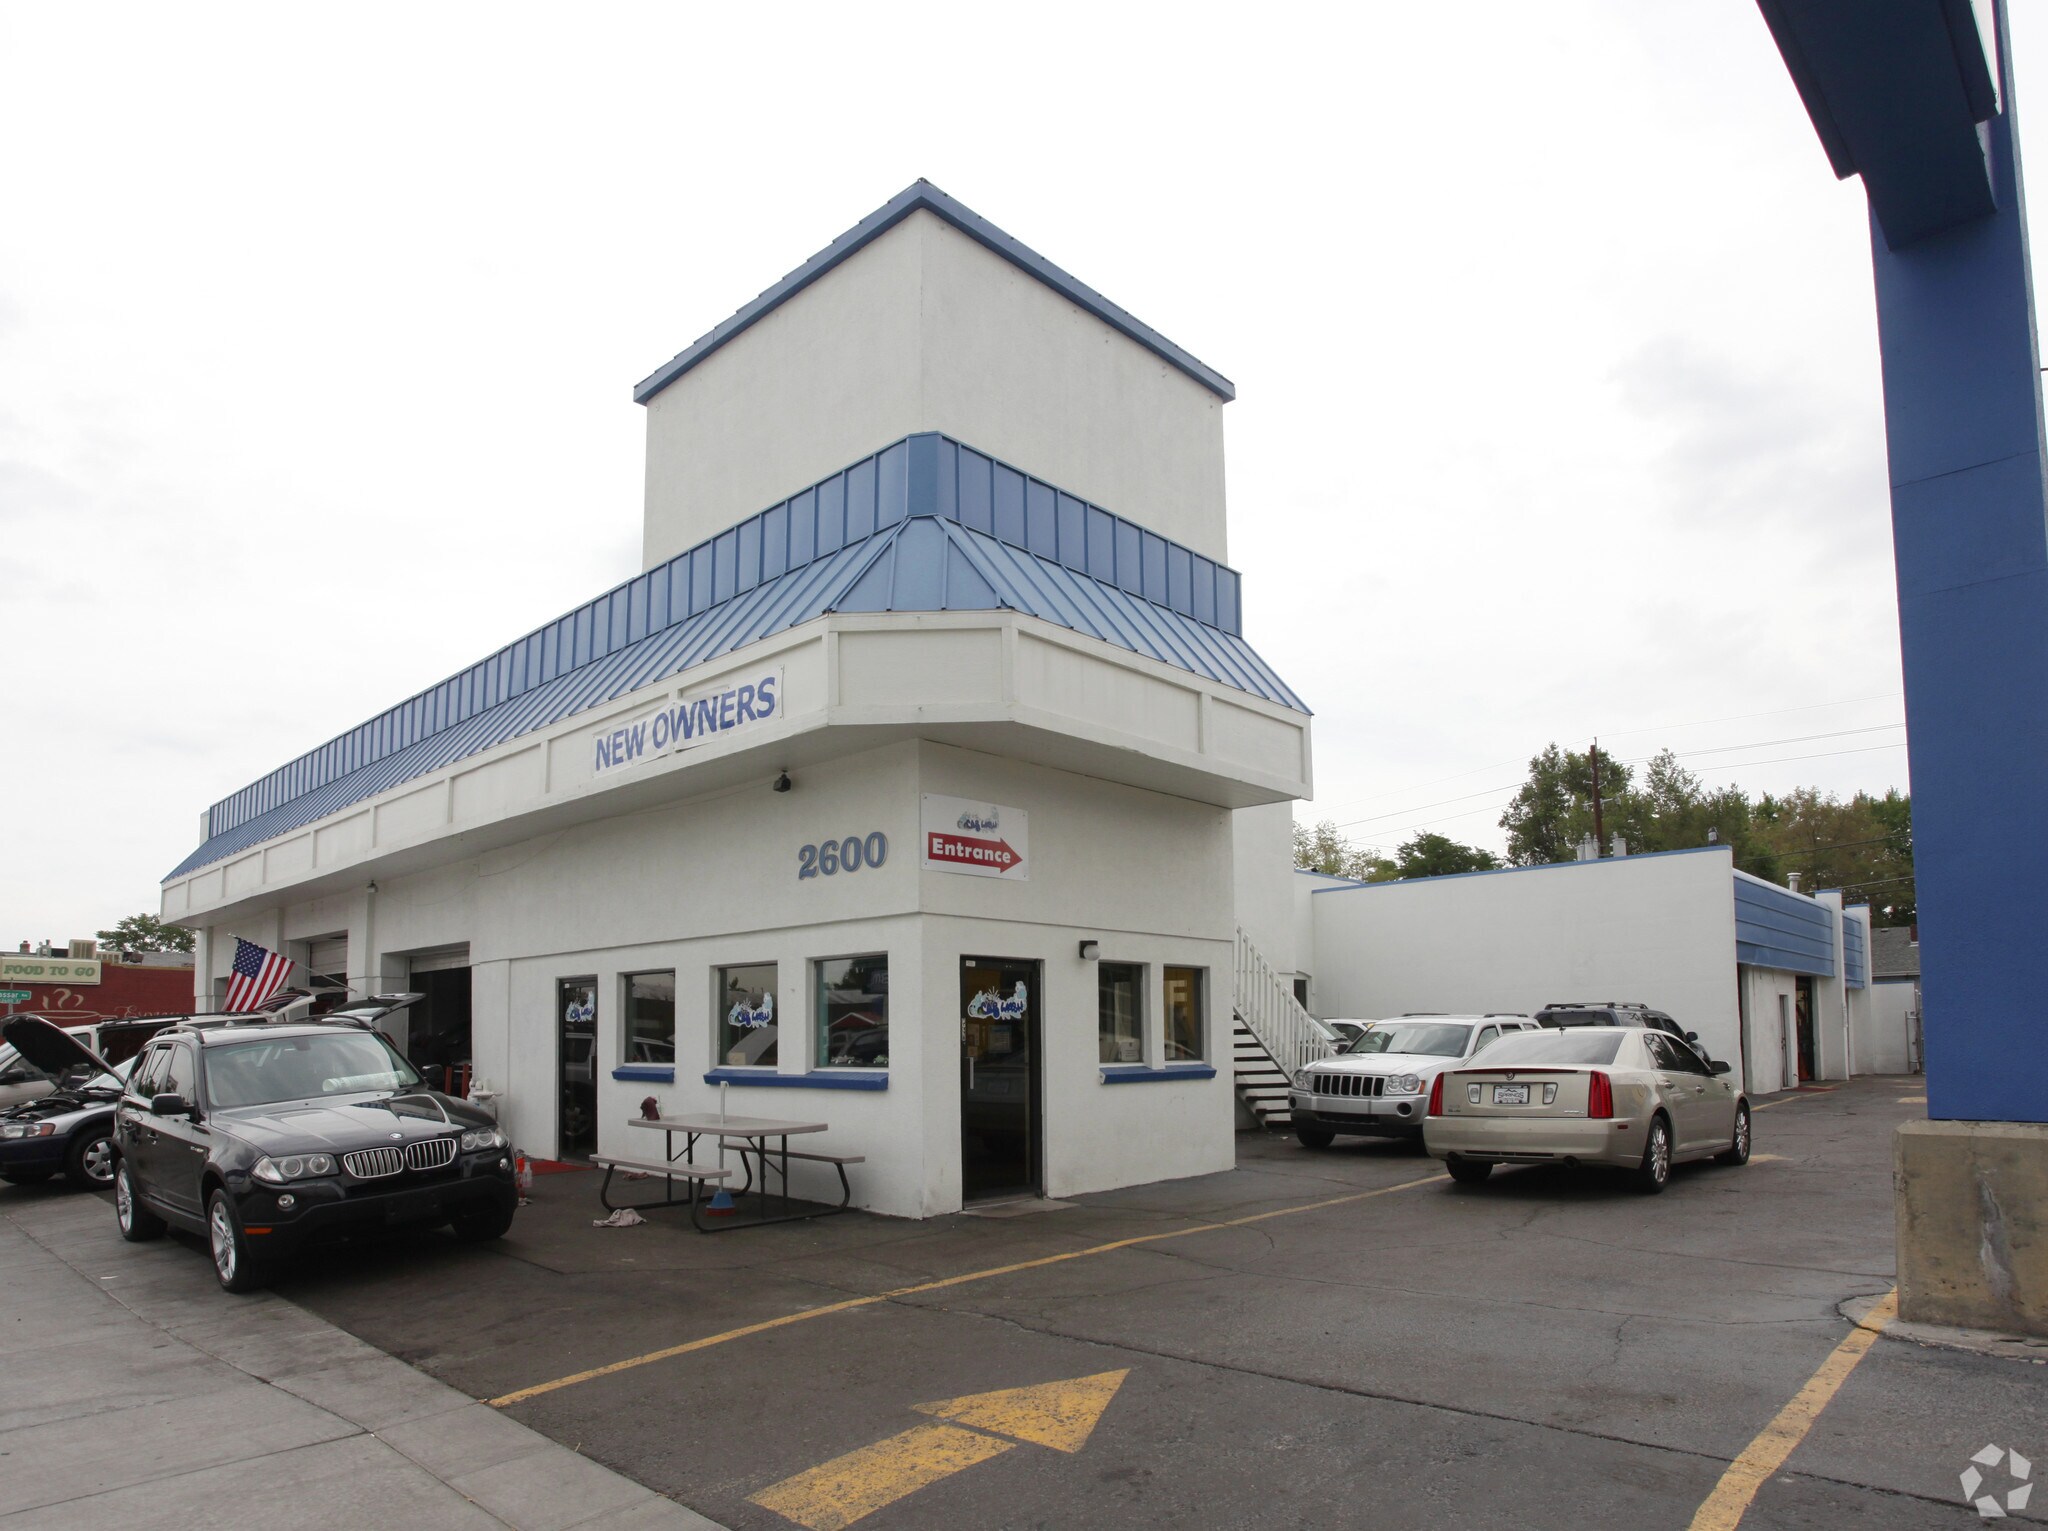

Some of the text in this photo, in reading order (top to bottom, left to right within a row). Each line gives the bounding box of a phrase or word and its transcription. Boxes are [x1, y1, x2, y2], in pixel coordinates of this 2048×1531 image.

[595, 676, 776, 771] NEW OWNERS
[798, 831, 888, 880] 2600
[932, 837, 1011, 864] Entrance
[3, 964, 96, 977] FOOD TO GO
